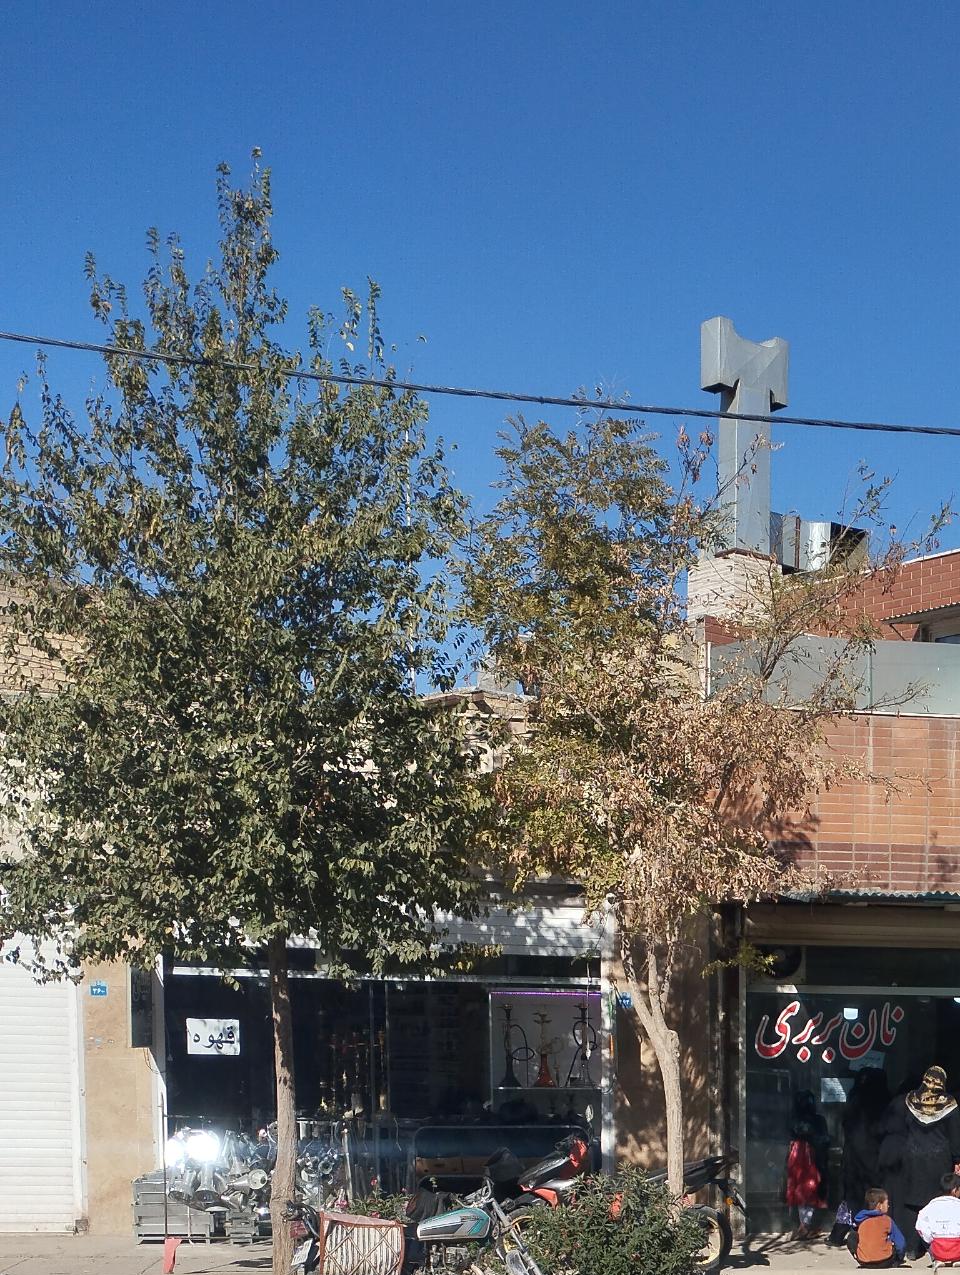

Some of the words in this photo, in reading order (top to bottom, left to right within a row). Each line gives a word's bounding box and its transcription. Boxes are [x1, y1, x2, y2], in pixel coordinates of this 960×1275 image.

[193, 1025, 235, 1050] قهوه
[754, 1001, 843, 1063] بربری
[838, 1002, 904, 1060] نان
